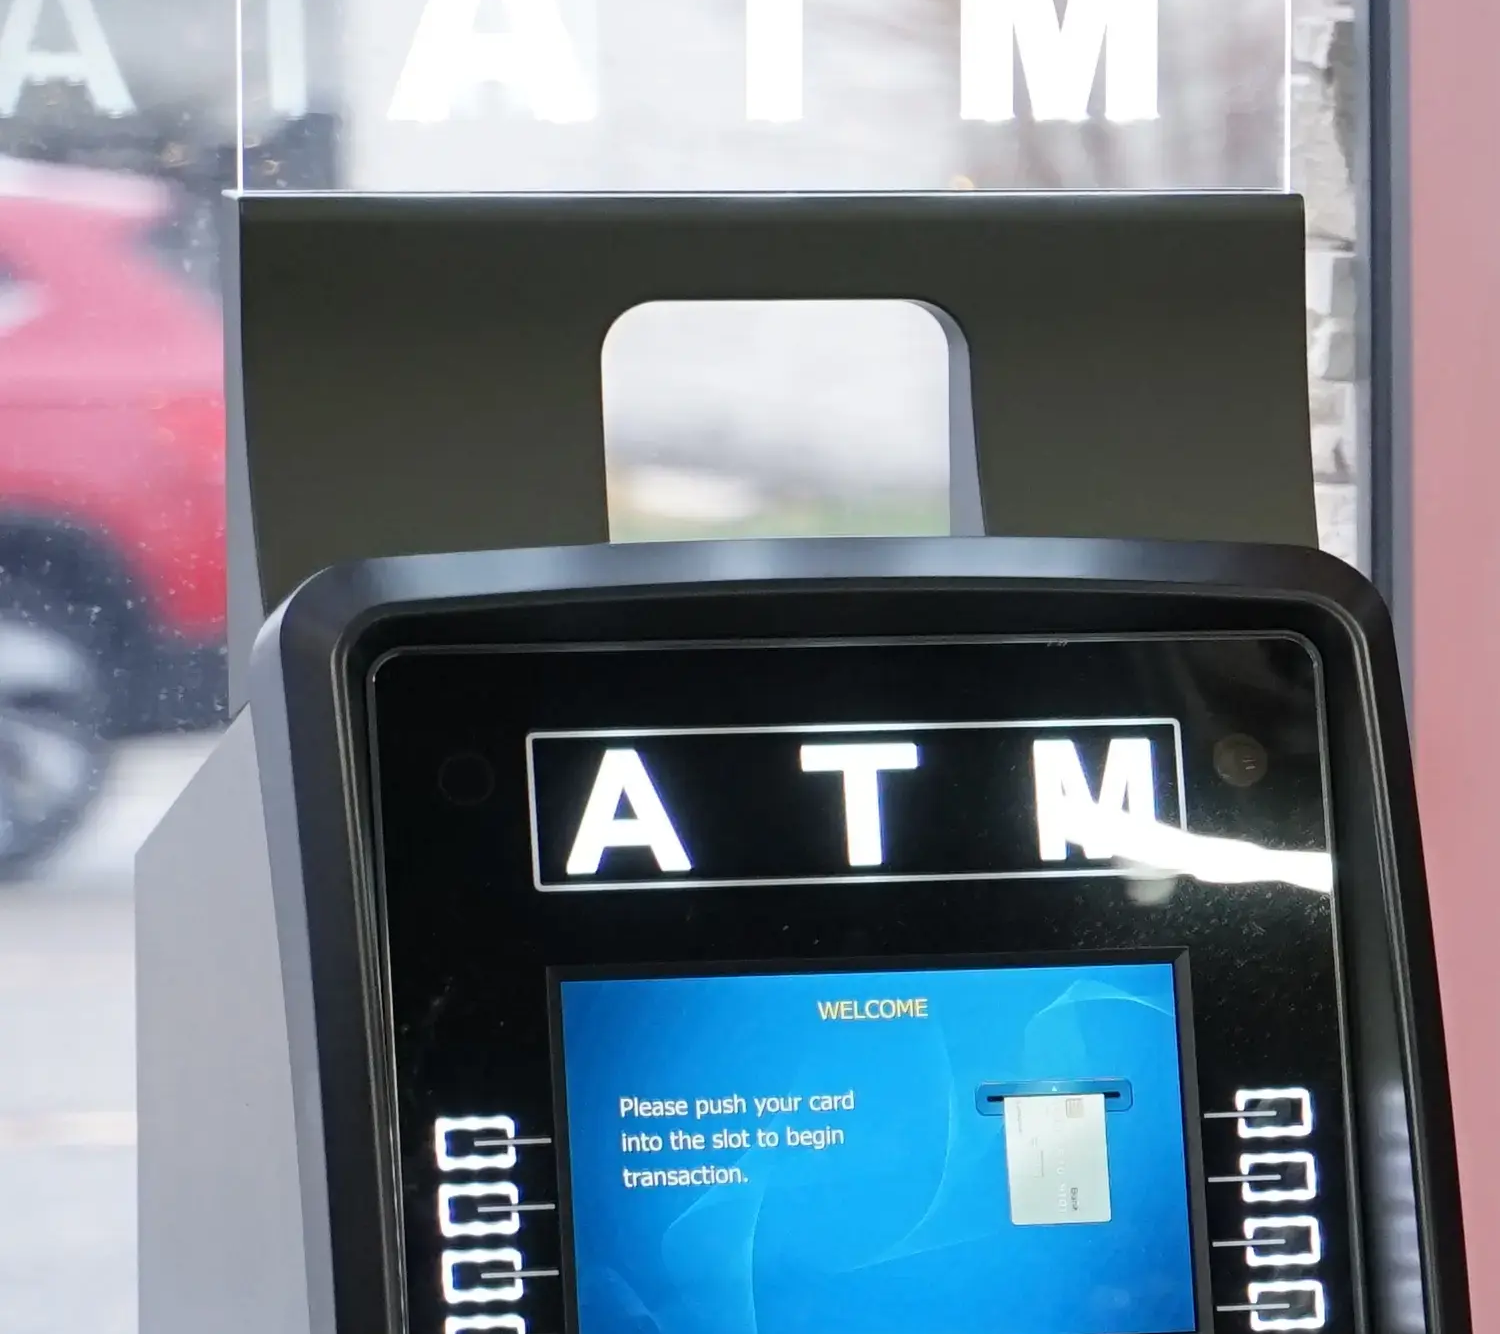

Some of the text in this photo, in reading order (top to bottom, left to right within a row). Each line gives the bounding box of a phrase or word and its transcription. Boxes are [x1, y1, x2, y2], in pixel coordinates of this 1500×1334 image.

[816, 997, 930, 1021] WELCOME
[619, 1090, 855, 1119] Please push your card
[621, 1126, 844, 1153] into the slot to begin
[623, 1165, 749, 1188] transaction.
